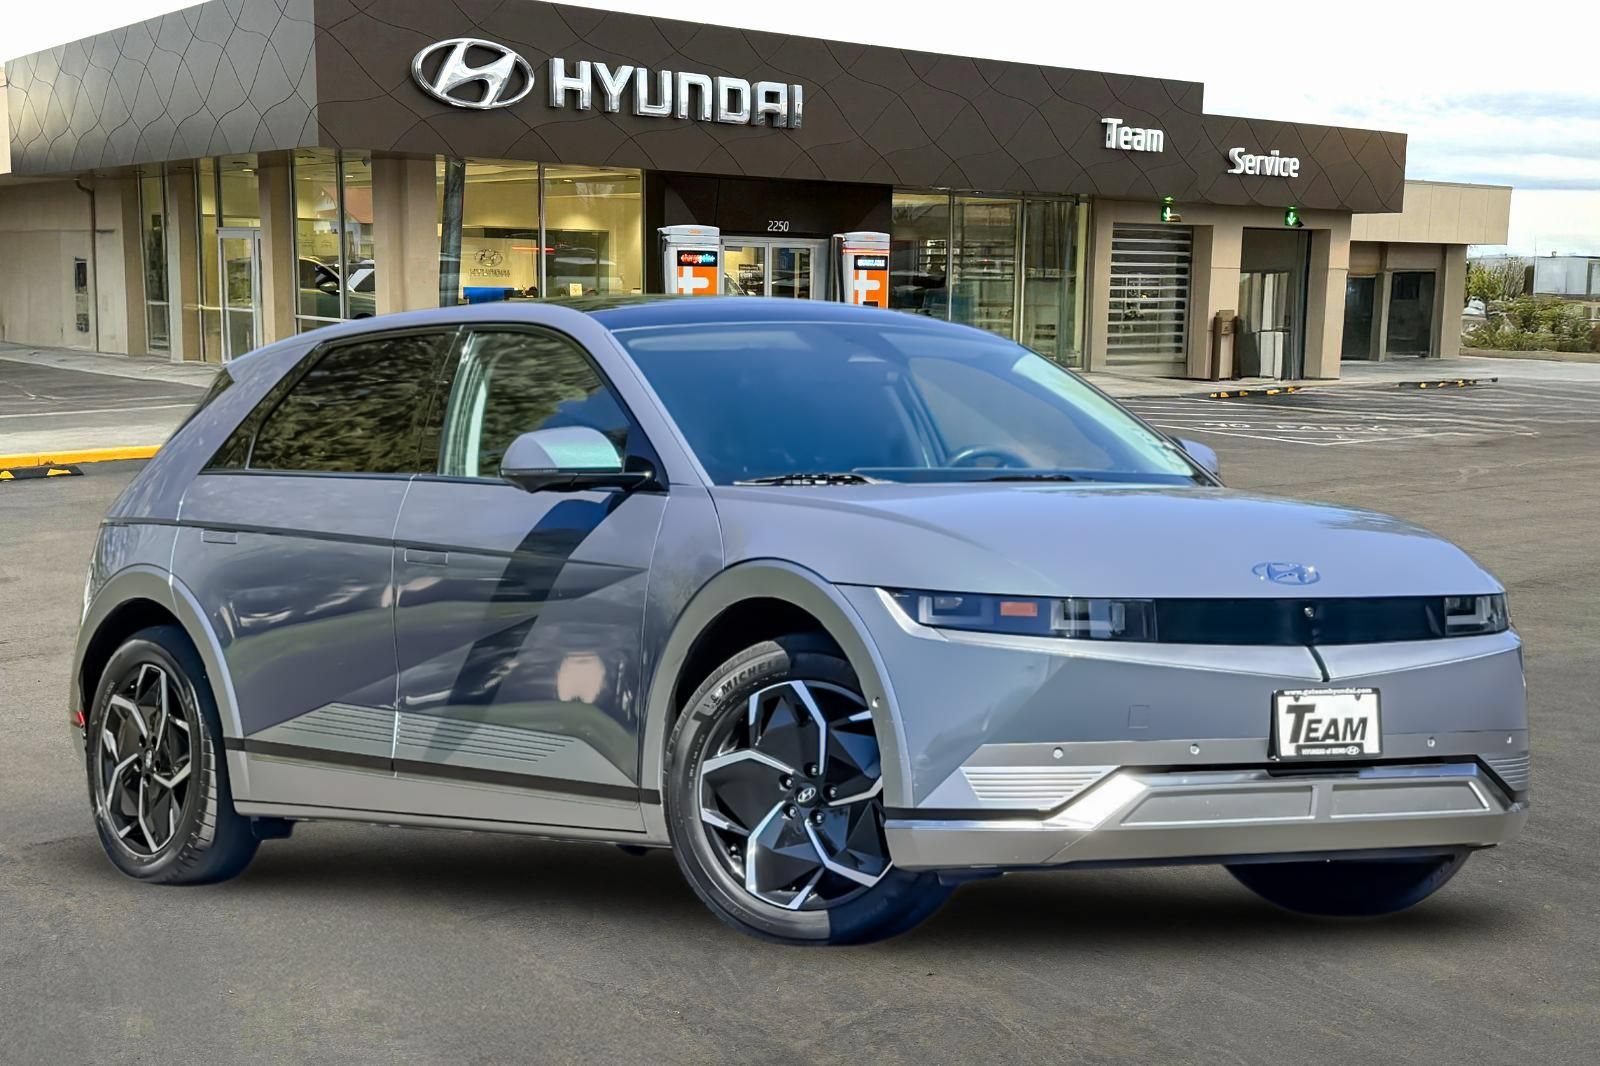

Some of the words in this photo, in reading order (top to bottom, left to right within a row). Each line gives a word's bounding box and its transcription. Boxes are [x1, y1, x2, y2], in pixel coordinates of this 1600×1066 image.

[549, 57, 803, 129] HYUNDAI
[1101, 117, 1164, 152] Team
[1227, 147, 1300, 177] Service
[767, 220, 790, 232] 2250
[1285, 704, 1368, 744] TEAM
